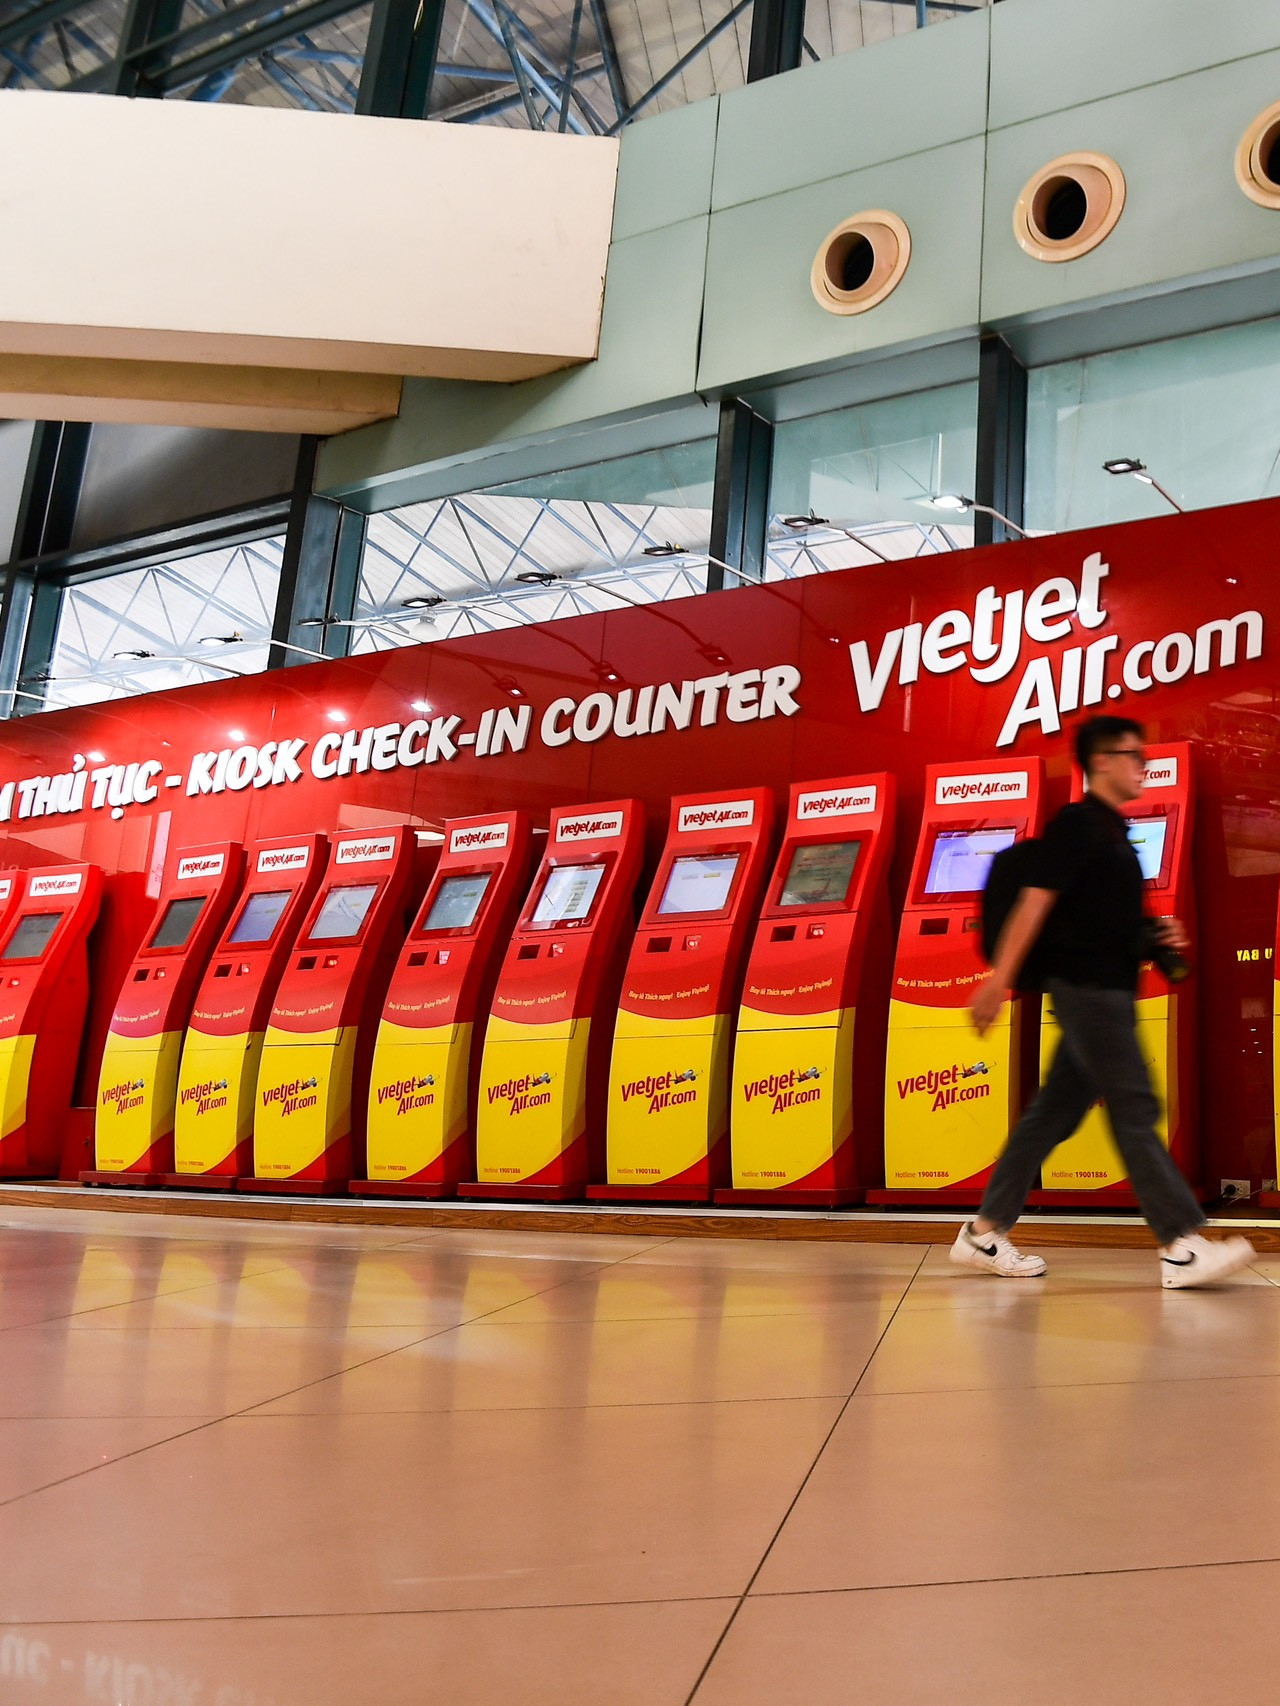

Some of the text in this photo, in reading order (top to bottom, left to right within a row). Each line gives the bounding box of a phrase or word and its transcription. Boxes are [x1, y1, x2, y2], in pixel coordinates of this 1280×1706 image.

[18, 753, 89, 819] THỦ
[91, 759, 163, 820] TỤC
[186, 737, 308, 797] KIOSK
[310, 704, 533, 780] CHECK-IN
[541, 663, 802, 748] COUNTER
